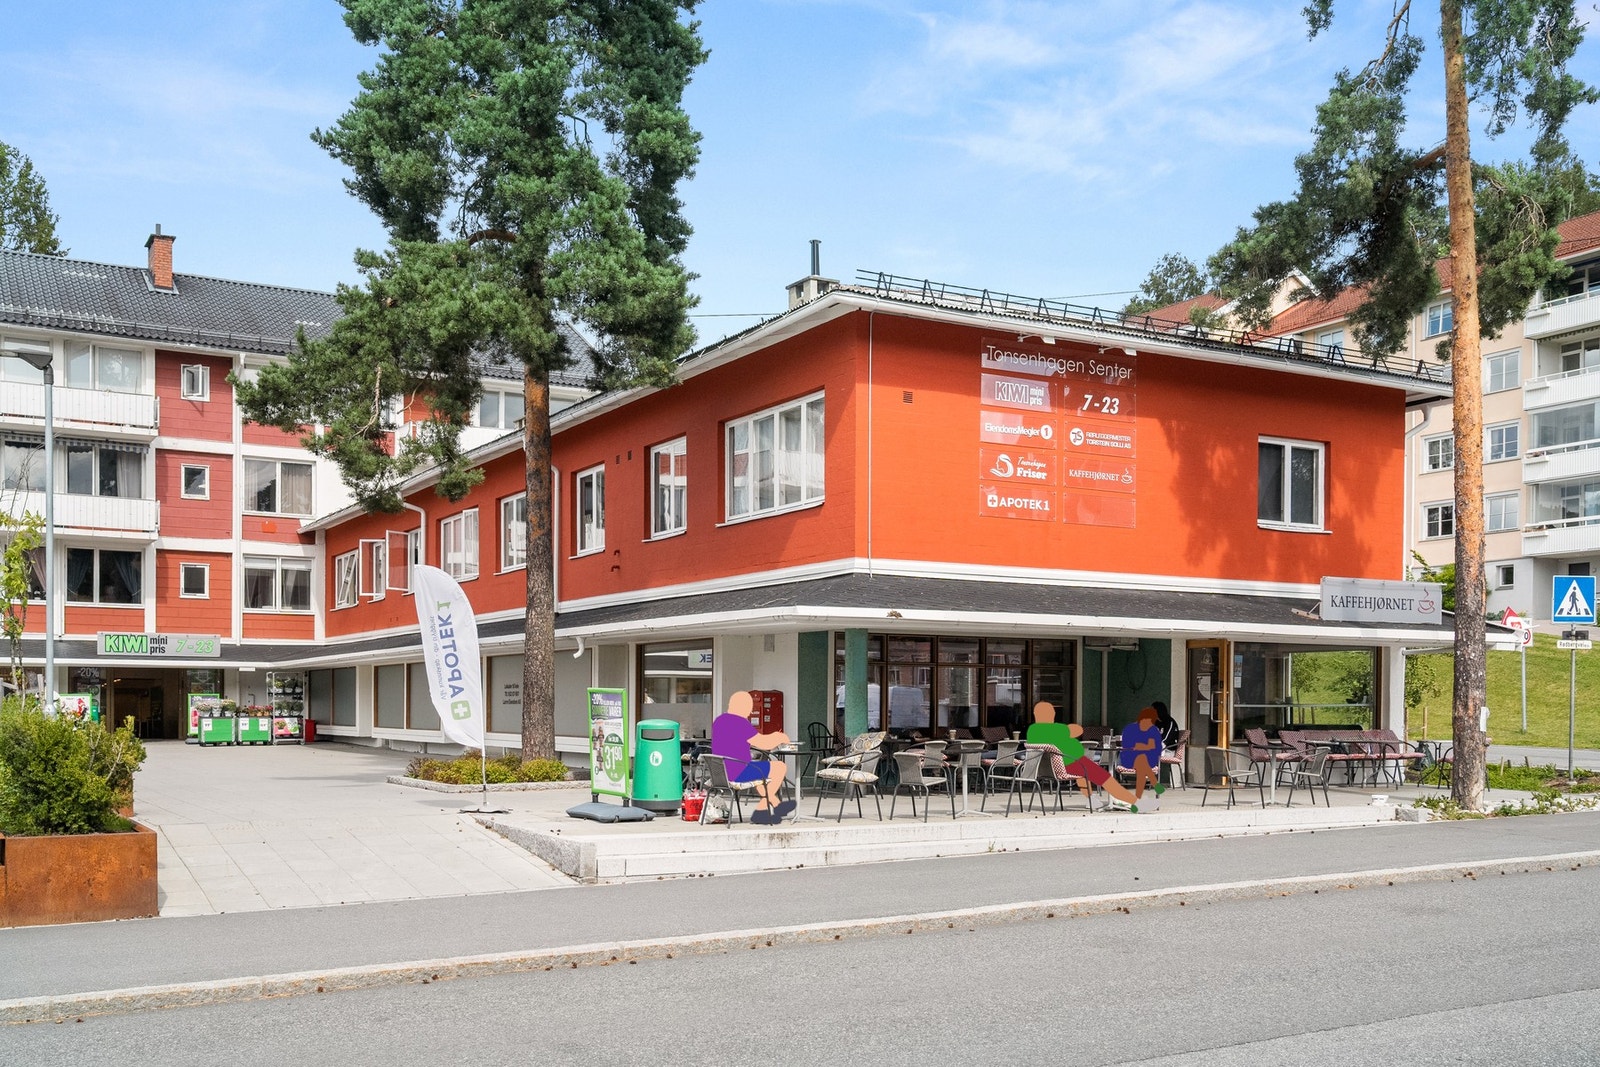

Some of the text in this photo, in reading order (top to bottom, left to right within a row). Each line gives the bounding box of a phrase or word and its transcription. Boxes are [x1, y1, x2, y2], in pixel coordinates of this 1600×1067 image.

[986, 345, 1132, 379] Tonsenhagen Senter
[995, 381, 1029, 404] KIWI
[1030, 387, 1044, 396] mini
[1030, 396, 1043, 406] pris
[984, 422, 1041, 438] EiendomsMegler
[1069, 469, 1120, 481] KAFFEHJØRNET
[1330, 595, 1414, 612] KAFFEHJØRNET
[104, 634, 148, 653] KIWI
[150, 635, 167, 645] mini
[150, 645, 166, 655] pris
[78, 667, 99, 677] -20%
